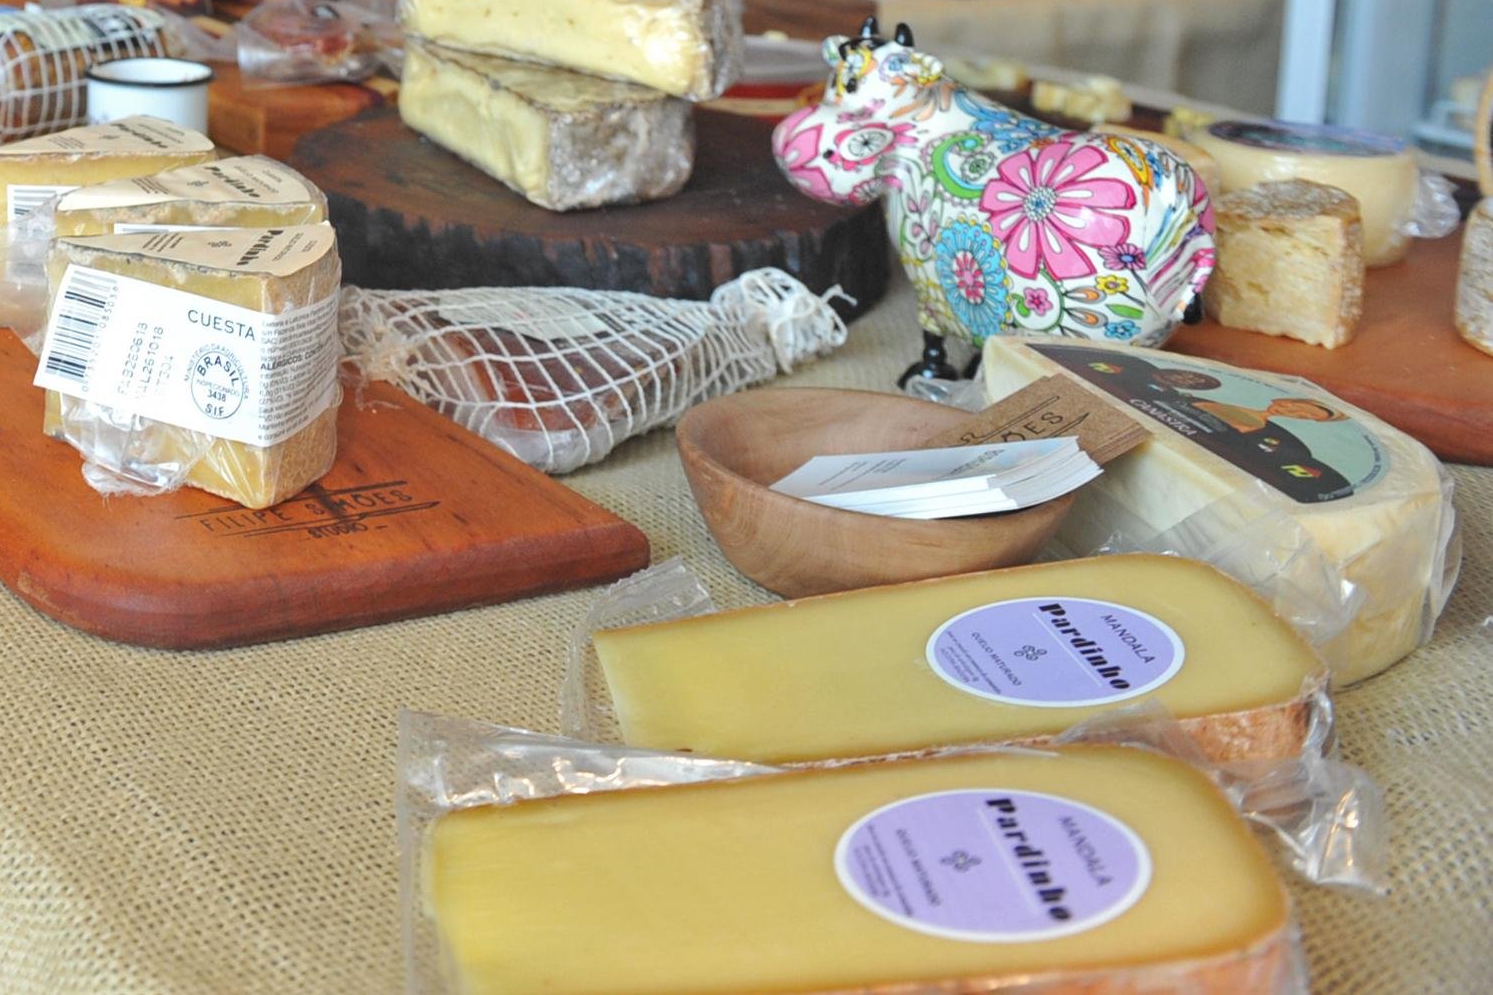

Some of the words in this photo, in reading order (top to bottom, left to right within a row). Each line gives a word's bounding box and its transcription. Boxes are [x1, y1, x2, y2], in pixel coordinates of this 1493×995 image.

[187, 309, 256, 341] CUESTA
[196, 355, 240, 387] BRASIL
[200, 505, 292, 532] FILIPE
[1038, 603, 1131, 690] Pardinho
[1100, 613, 1157, 665] MANDALA
[988, 651, 1023, 687] MATURADO
[985, 798, 1073, 921] Pardinho
[1059, 816, 1113, 887] MANDALA
